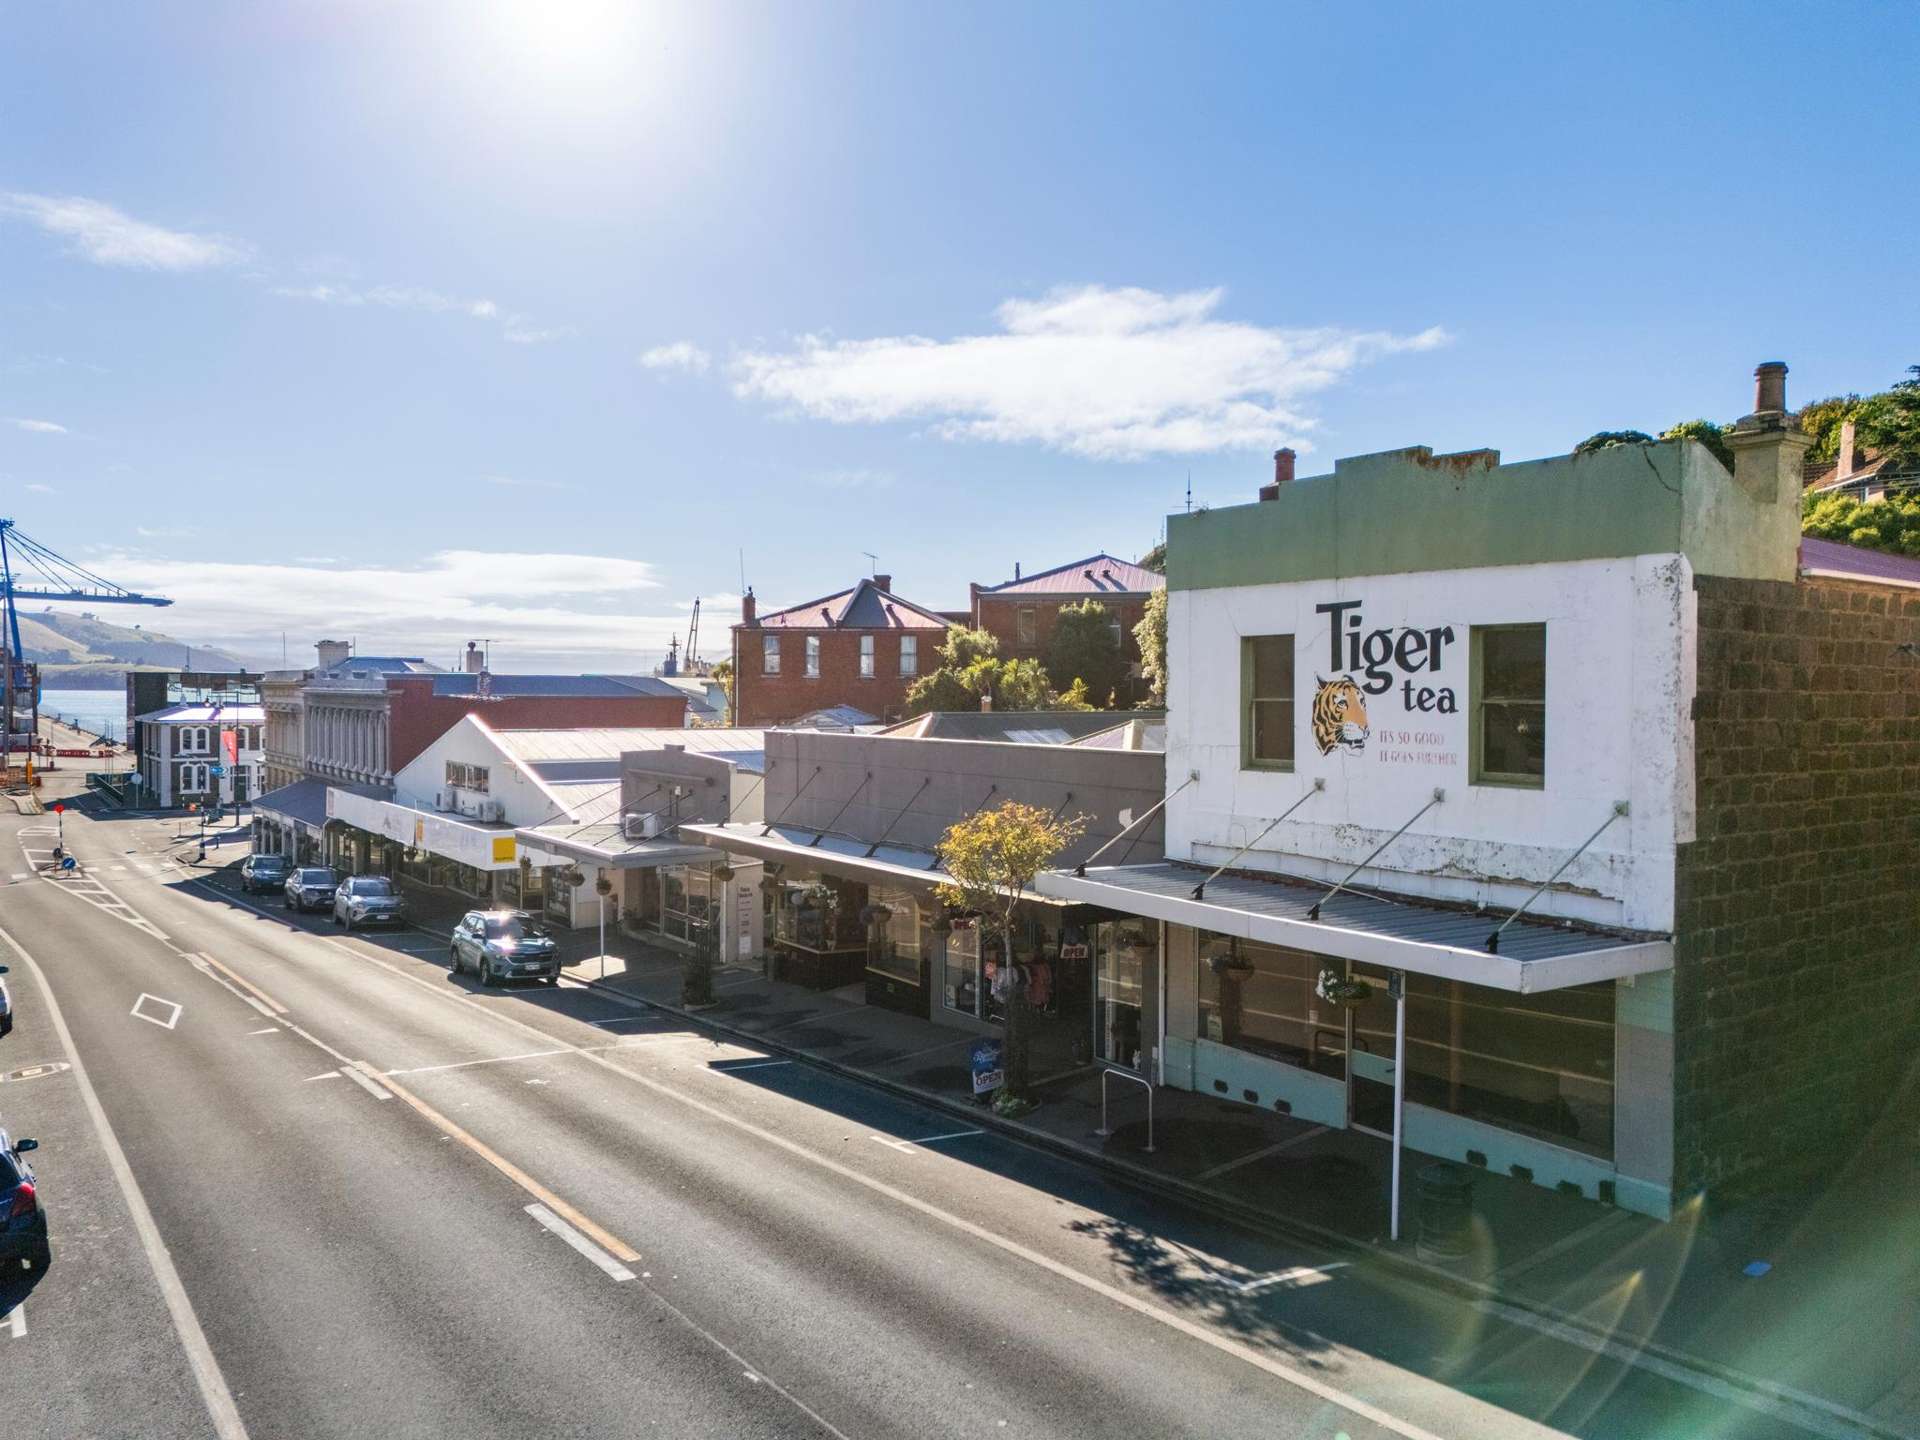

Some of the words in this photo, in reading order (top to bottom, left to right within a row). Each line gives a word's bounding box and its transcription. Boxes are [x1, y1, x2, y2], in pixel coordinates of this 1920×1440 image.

[1316, 600, 1455, 695] Tiger
[1400, 679, 1459, 714] tea
[1398, 731, 1410, 744] SO
[1414, 732, 1445, 745] GOOD
[1380, 750, 1388, 762] IT
[1064, 947, 1085, 957] OPEN
[976, 1071, 1001, 1086] OPEN
